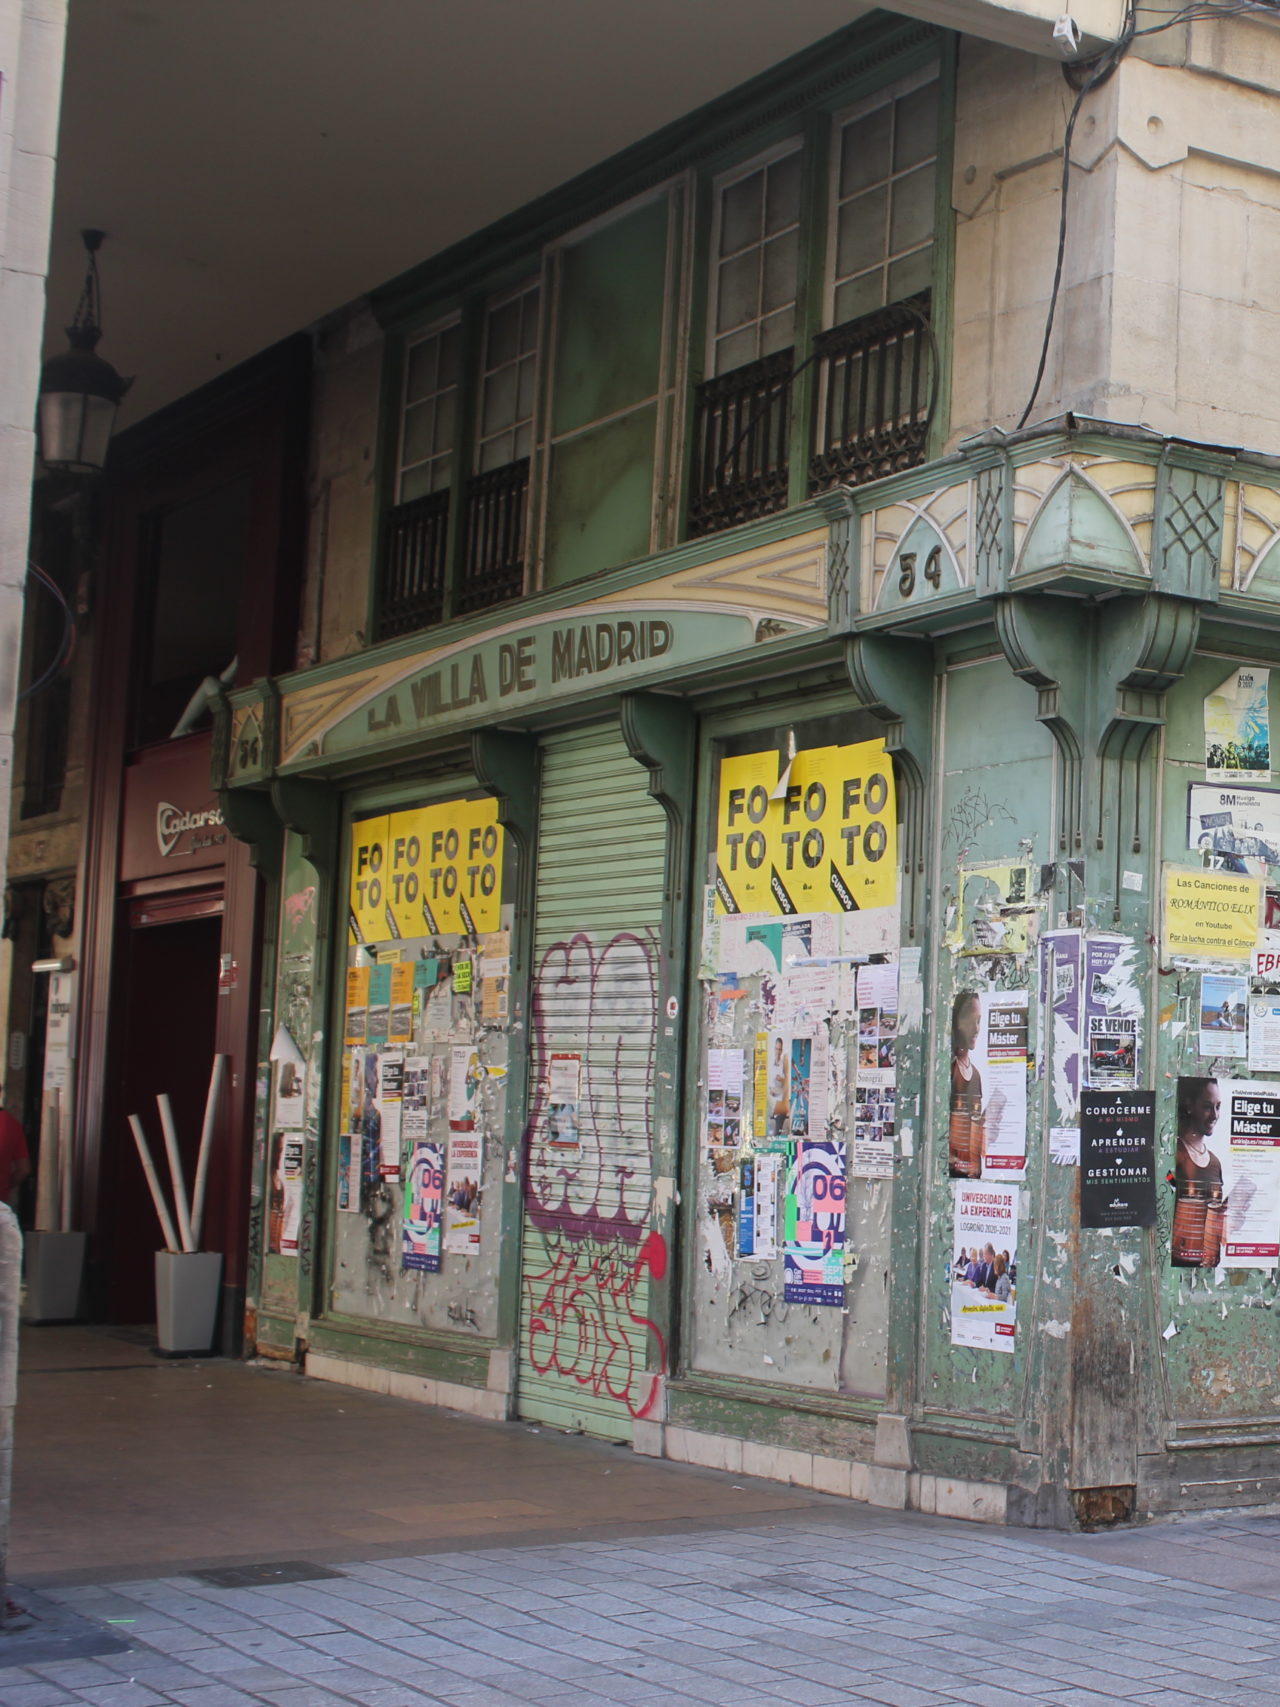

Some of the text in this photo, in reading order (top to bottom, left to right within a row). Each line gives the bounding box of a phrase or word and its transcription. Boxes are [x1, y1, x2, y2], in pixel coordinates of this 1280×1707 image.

[368, 620, 674, 733] LA VILLA DE MADRID
[728, 785, 768, 827] FO
[784, 781, 826, 825] FO
[843, 773, 888, 820] FO
[1219, 794, 1237, 807] 8M
[394, 835, 420, 869] FO
[431, 828, 459, 863] FO
[468, 825, 498, 860] FO
[726, 830, 767, 871] TO
[782, 828, 825, 870] TO
[841, 821, 887, 866] TO
[357, 843, 383, 876] FO
[356, 877, 382, 910] TO
[392, 872, 418, 904] TO
[430, 865, 458, 899] TO
[467, 863, 496, 898] TO
[771, 876, 792, 912] CURSOS
[831, 873, 854, 911] CURSOS
[1177, 879, 1250, 893] Las Canciones de
[716, 877, 735, 912] CURSOS
[1169, 898, 1256, 915] ROMÁNTICO ELIX
[1205, 921, 1233, 930] Youtube
[1169, 932, 1181, 941] Por
[1189, 935, 1206, 943] lucha
[1206, 936, 1227, 945] contra
[1234, 938, 1256, 948] Cáncer
[989, 1010, 1020, 1027] Elige tu
[1090, 1017, 1137, 1033] SE VENDE
[989, 1031, 1019, 1045] Máster
[1085, 1106, 1151, 1116] CONOCERME
[1234, 1099, 1275, 1116] Elige tu
[1232, 1119, 1272, 1134] Máster
[1091, 1137, 1147, 1147] APRENDER
[421, 1168, 444, 1190] 06
[1087, 1167, 1148, 1177] GESTIONAR
[1100, 1177, 1151, 1185] SENTIMIENTOS
[813, 1174, 846, 1201] 06
[961, 1191, 1012, 1207] UNIVERSIDAD DE
[960, 1204, 1012, 1219] LA EXPERIENCIA
[960, 1221, 984, 1233] LOGROÑO
